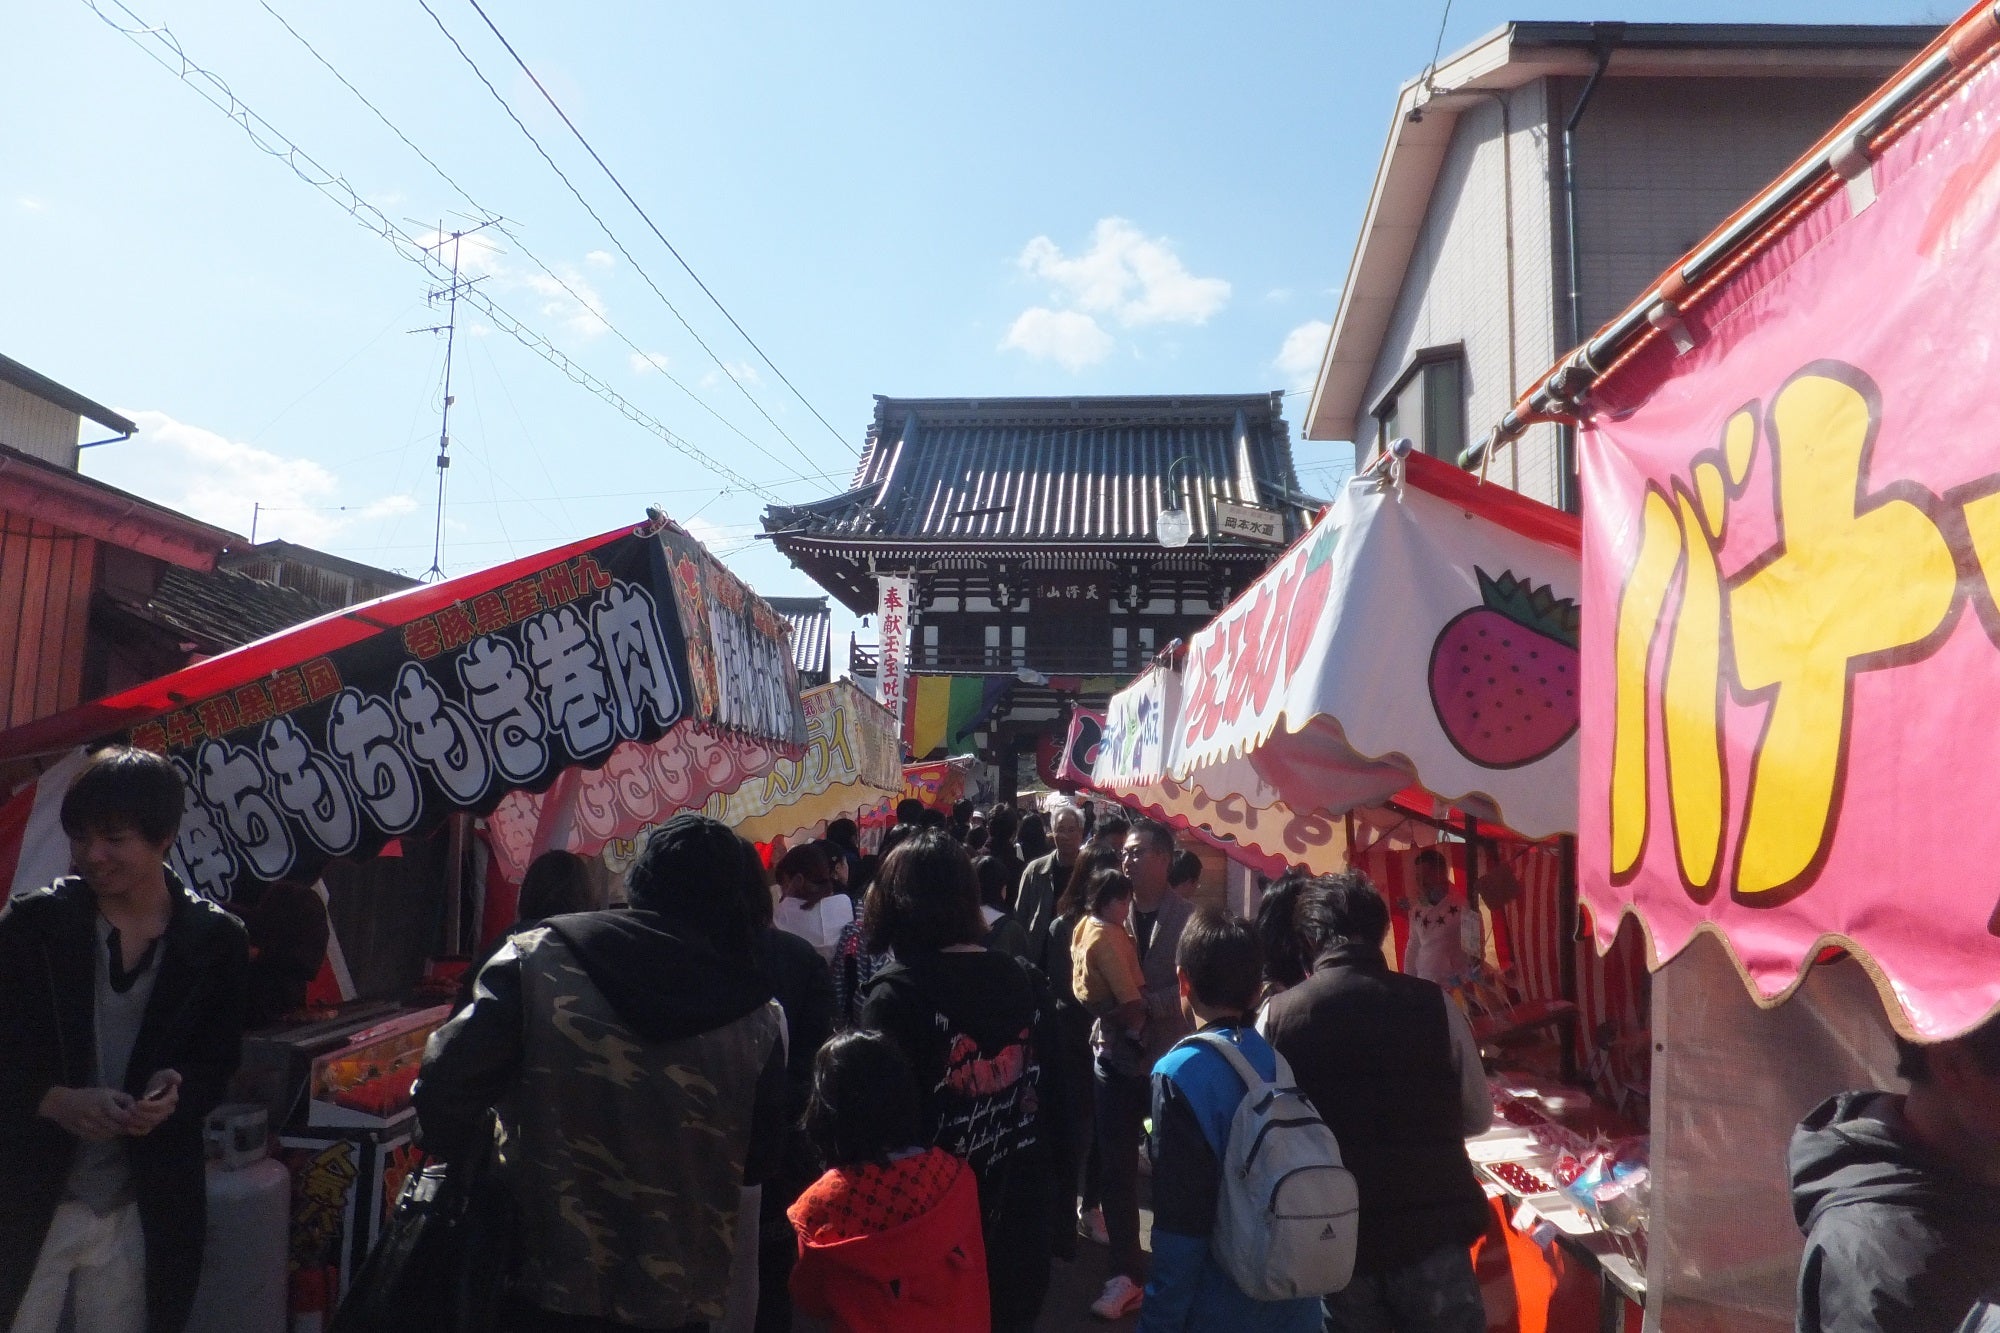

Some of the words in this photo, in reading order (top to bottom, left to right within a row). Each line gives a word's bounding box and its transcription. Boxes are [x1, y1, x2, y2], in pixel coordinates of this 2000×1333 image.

[1224, 515, 1275, 537] 岡本水道
[1609, 355, 2000, 907] バナ
